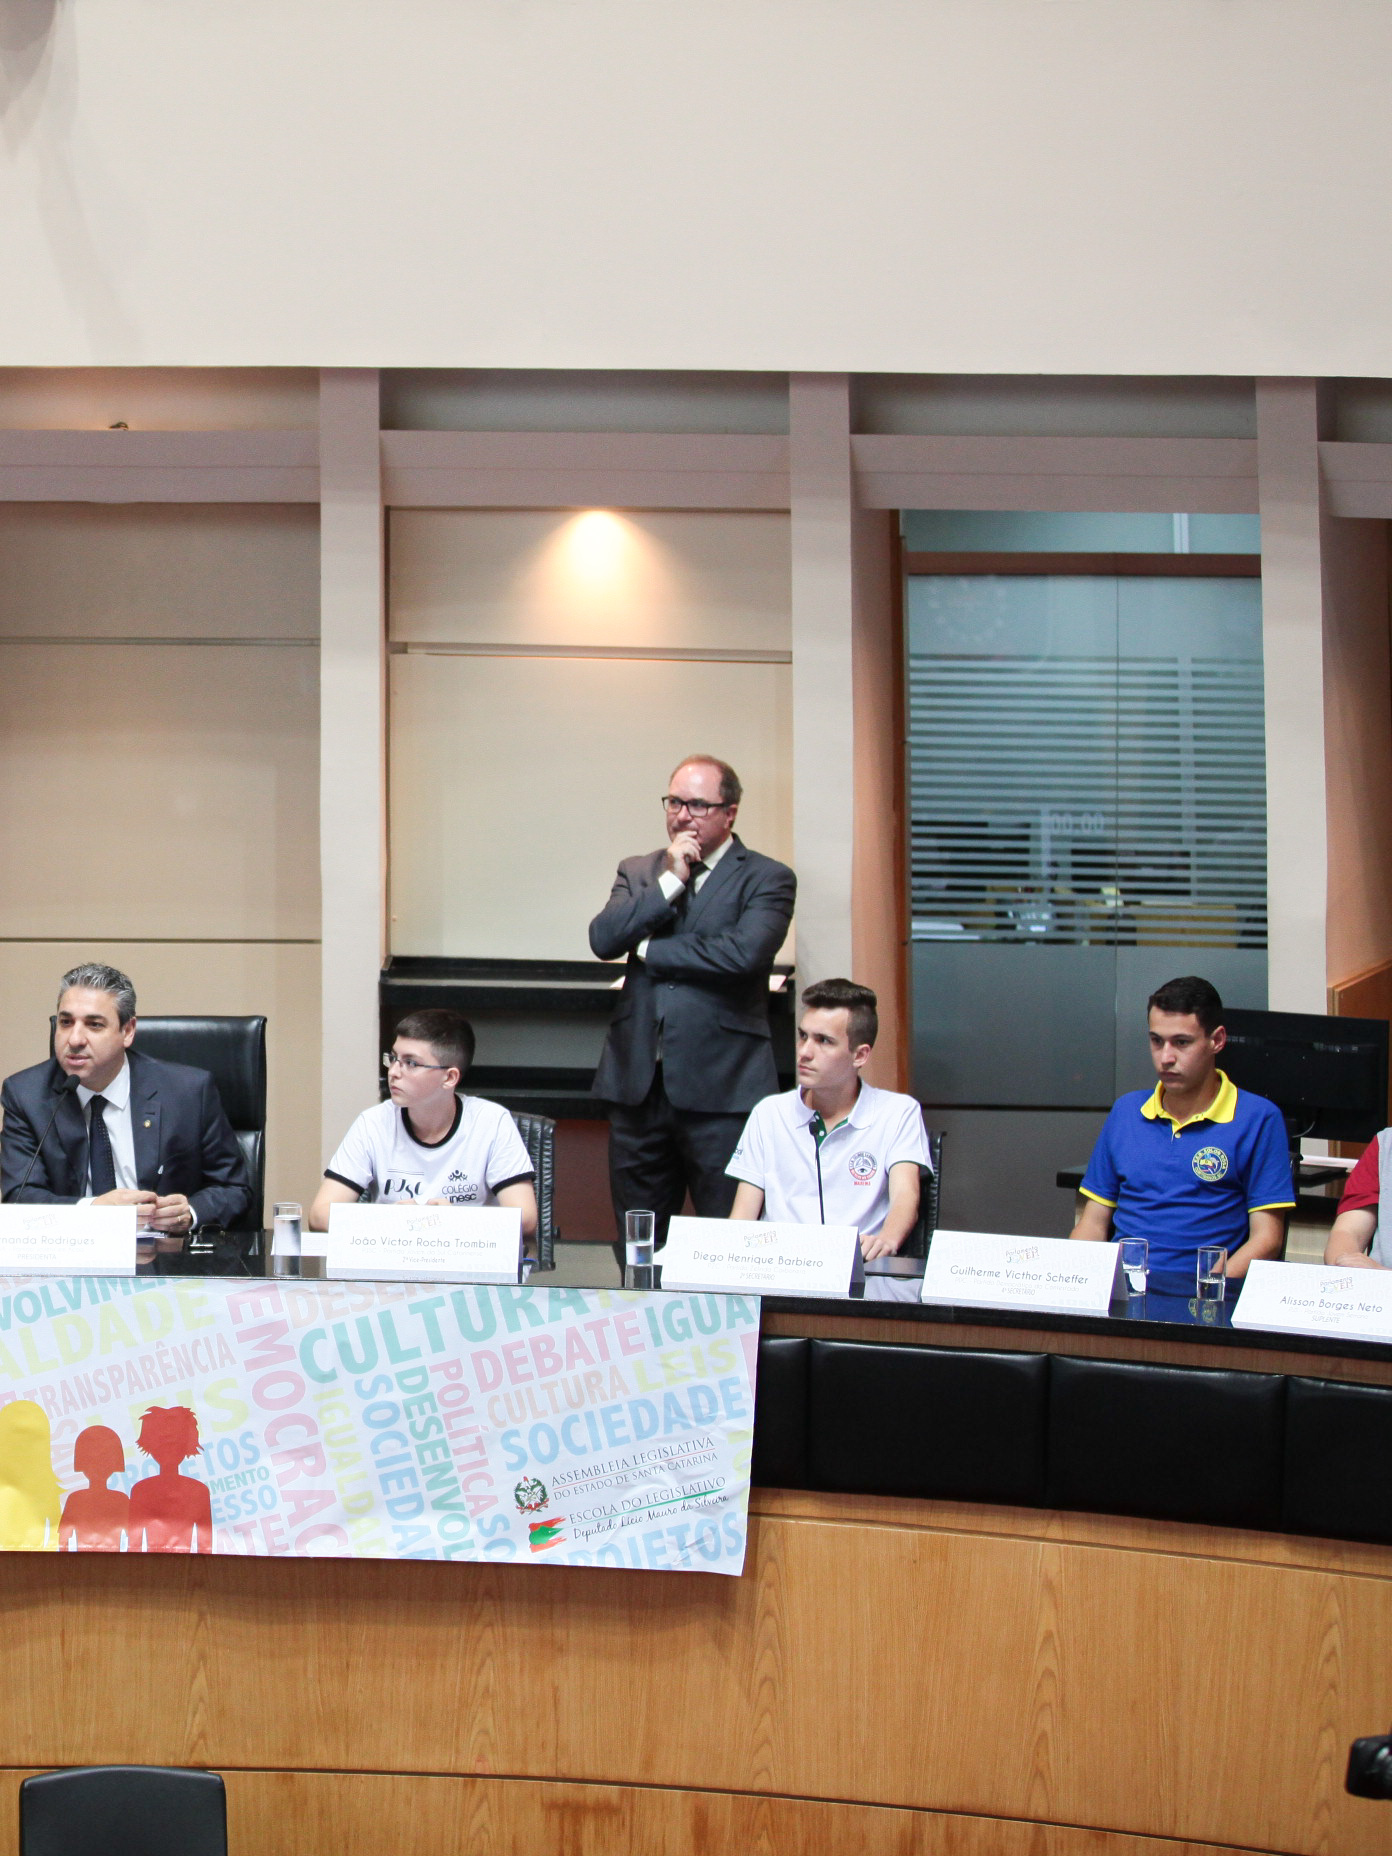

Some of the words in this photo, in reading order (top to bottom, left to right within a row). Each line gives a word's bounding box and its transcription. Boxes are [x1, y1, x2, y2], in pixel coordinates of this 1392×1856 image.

[441, 1182, 479, 1194] COLÉGIO
[41, 1235, 95, 1247] Rodrigues
[350, 1236, 377, 1246] João
[380, 1236, 413, 1247] Victor
[416, 1238, 451, 1248] Rocha
[454, 1238, 497, 1249] Trombim
[693, 1250, 724, 1262] Diego
[727, 1253, 774, 1265] Henrique
[777, 1255, 824, 1268] Barbiero
[950, 1264, 1001, 1279] Guilherme
[1005, 1269, 1042, 1281] Victhor
[1045, 1272, 1089, 1285] Scheffer
[644, 1293, 761, 1348] IGUA
[1279, 1295, 1315, 1307] Alisson
[1318, 1298, 1354, 1311] Borges
[1357, 1302, 1383, 1313] Neto
[298, 1284, 591, 1384] CULTURA
[469, 1310, 647, 1394] DEBATE
[22, 1331, 238, 1420] TRANSPARÊNCIA
[632, 1337, 738, 1393] LEIS
[487, 1364, 631, 1428] CULTURA
[428, 1358, 499, 1518] POLÍTICA
[500, 1375, 749, 1473] SOCIEDADE
[311, 1388, 388, 1558] IGUALDAD
[394, 1364, 478, 1562] DESENVOL
[551, 1457, 630, 1487] ASSEMBLEIA
[632, 1436, 715, 1466] LEGISLATIVA
[553, 1489, 571, 1501] DO
[574, 1479, 613, 1495] ESTADO
[615, 1475, 629, 1486] DE
[632, 1465, 666, 1481] SANTA
[667, 1452, 719, 1471] CATARINA
[569, 1501, 619, 1525] ESCOLA
[621, 1497, 642, 1512] DO
[645, 1476, 727, 1505] LEGISLATIVO
[573, 1518, 618, 1543] Deputado
[646, 1506, 678, 1522] Mauro
[680, 1498, 694, 1513] da
[694, 1494, 730, 1510] Silveira
